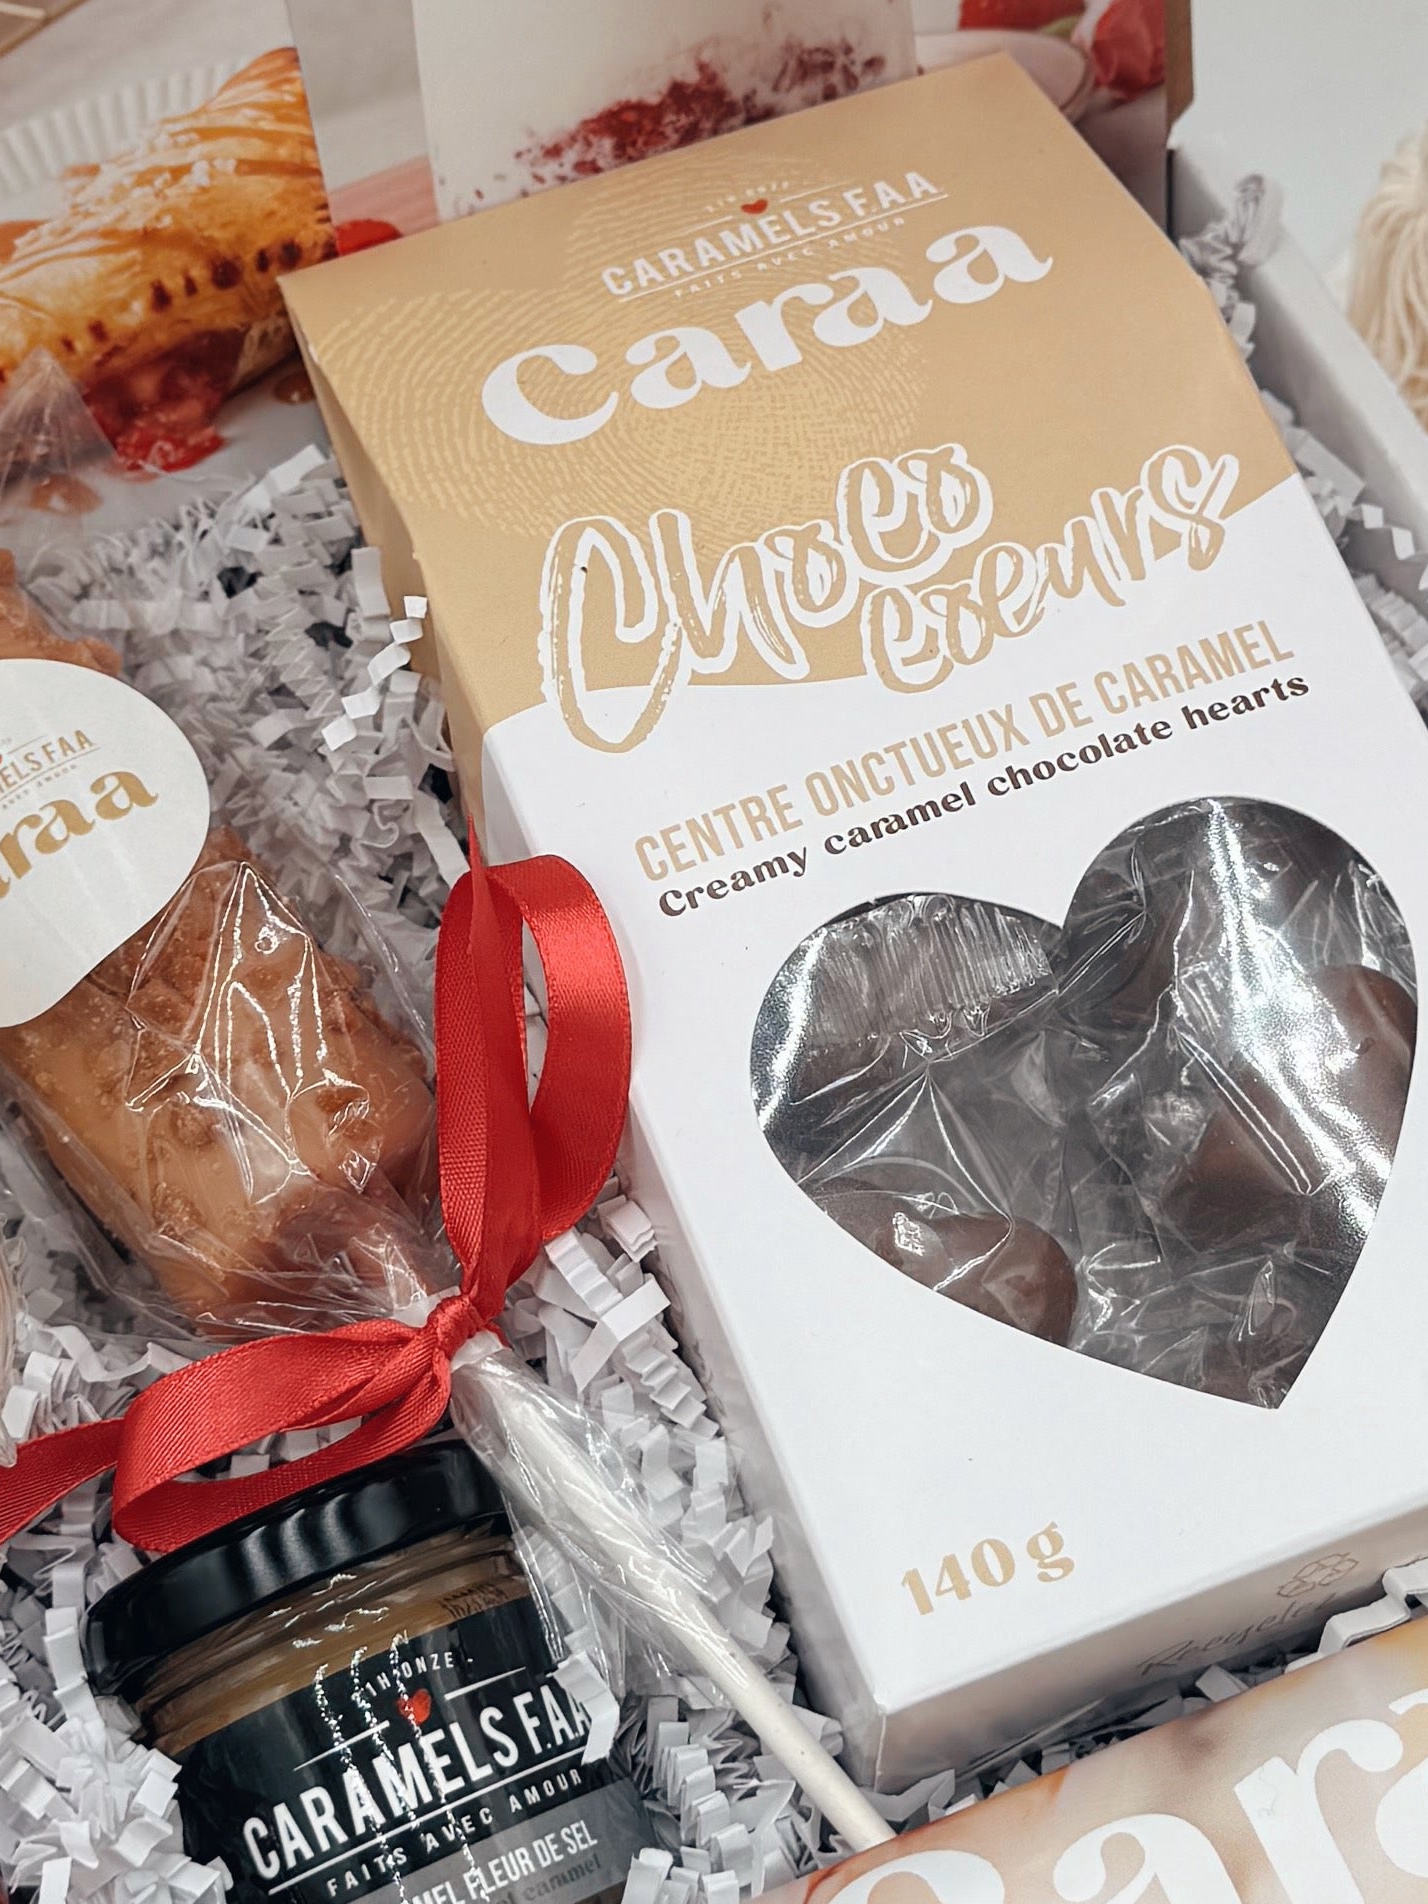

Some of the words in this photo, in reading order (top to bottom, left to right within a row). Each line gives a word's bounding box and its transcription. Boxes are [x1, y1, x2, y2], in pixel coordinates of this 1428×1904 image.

[601, 199, 843, 296] CARAMELS
[538, 442, 993, 753] Choco
[633, 783, 804, 883] CENTRE
[804, 711, 1024, 817] ONCTUEUX
[1023, 690, 1093, 739] DE
[1094, 620, 1294, 719] CARAMEL
[658, 844, 809, 918] Creamy
[823, 781, 976, 857] caramel
[987, 715, 1174, 798] chocolate
[1180, 671, 1310, 732] hearts
[901, 1536, 1016, 1616] 140
[1027, 1521, 1077, 1584] g
[401, 1652, 455, 1678] ONZE
[243, 1705, 519, 1880] CARAMELS
[326, 1847, 408, 1898] FAITS
[424, 1806, 493, 1852] AVEC
[508, 1767, 584, 1812] AMOUR
[462, 1845, 536, 1901] FLEUR
[531, 1826, 565, 1869] DE
[559, 1818, 599, 1856] SEL
